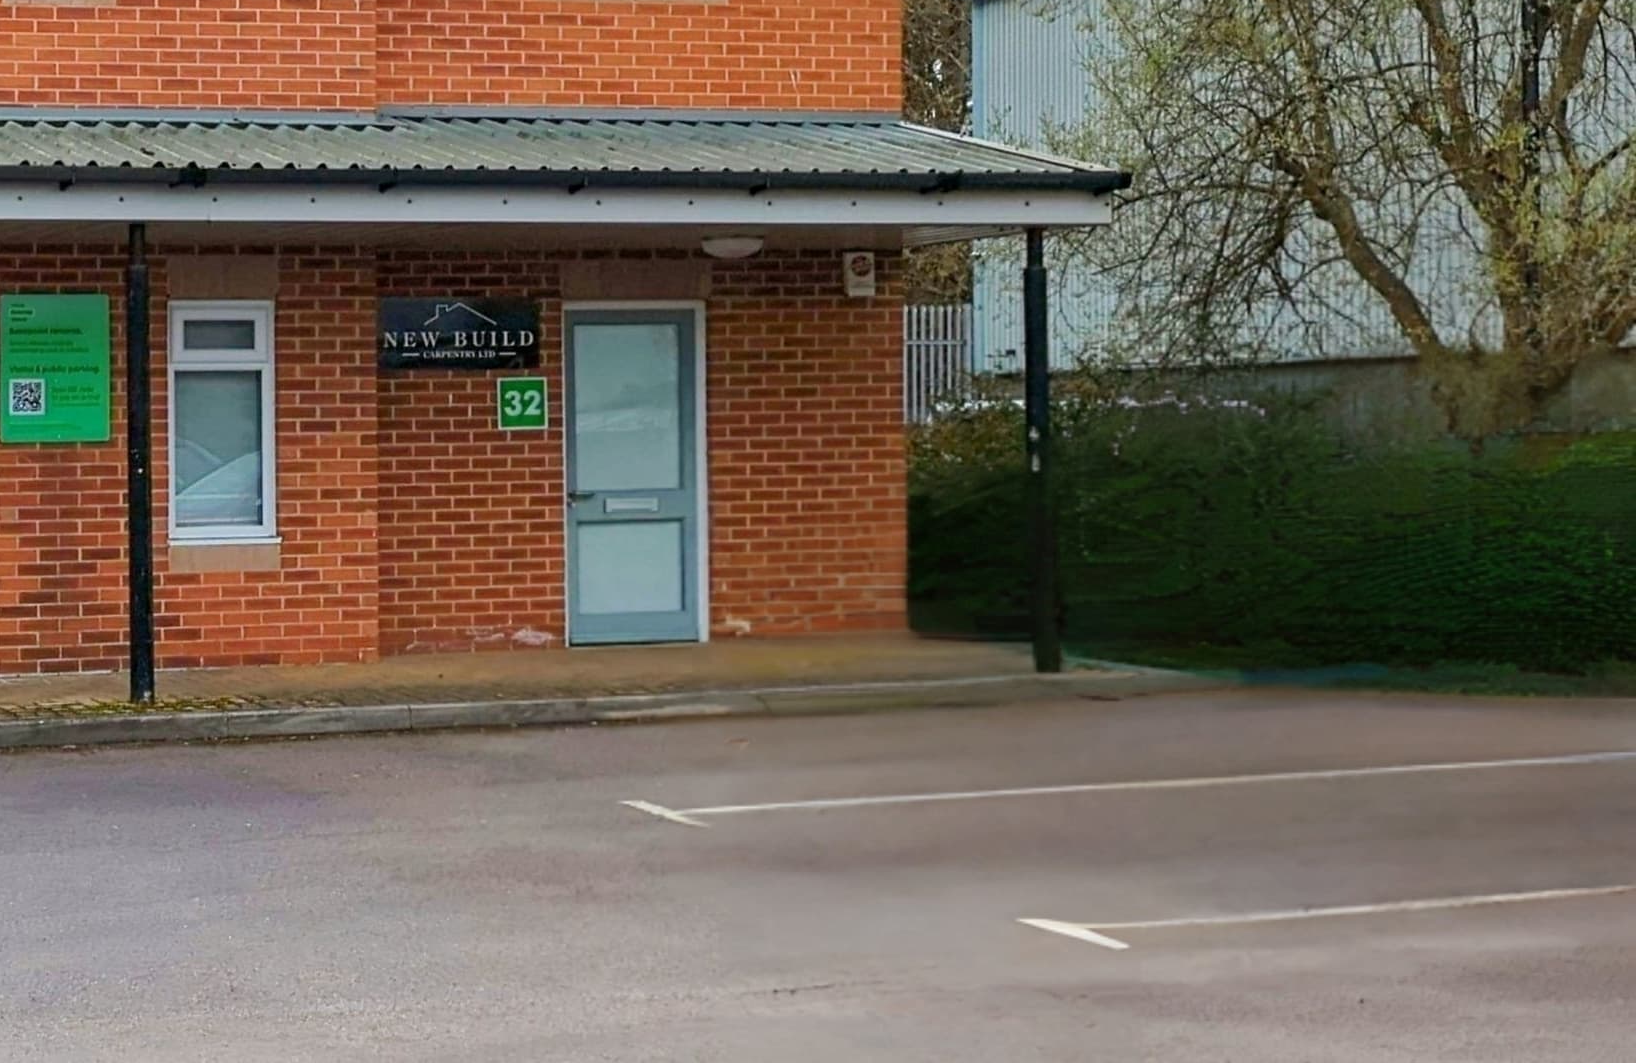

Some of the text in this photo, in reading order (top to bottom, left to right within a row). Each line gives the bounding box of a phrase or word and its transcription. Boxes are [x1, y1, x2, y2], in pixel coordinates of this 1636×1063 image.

[383, 331, 535, 348] NEW BUILD
[423, 350, 496, 359] CARPENTRY LTD
[504, 390, 541, 417] 32
